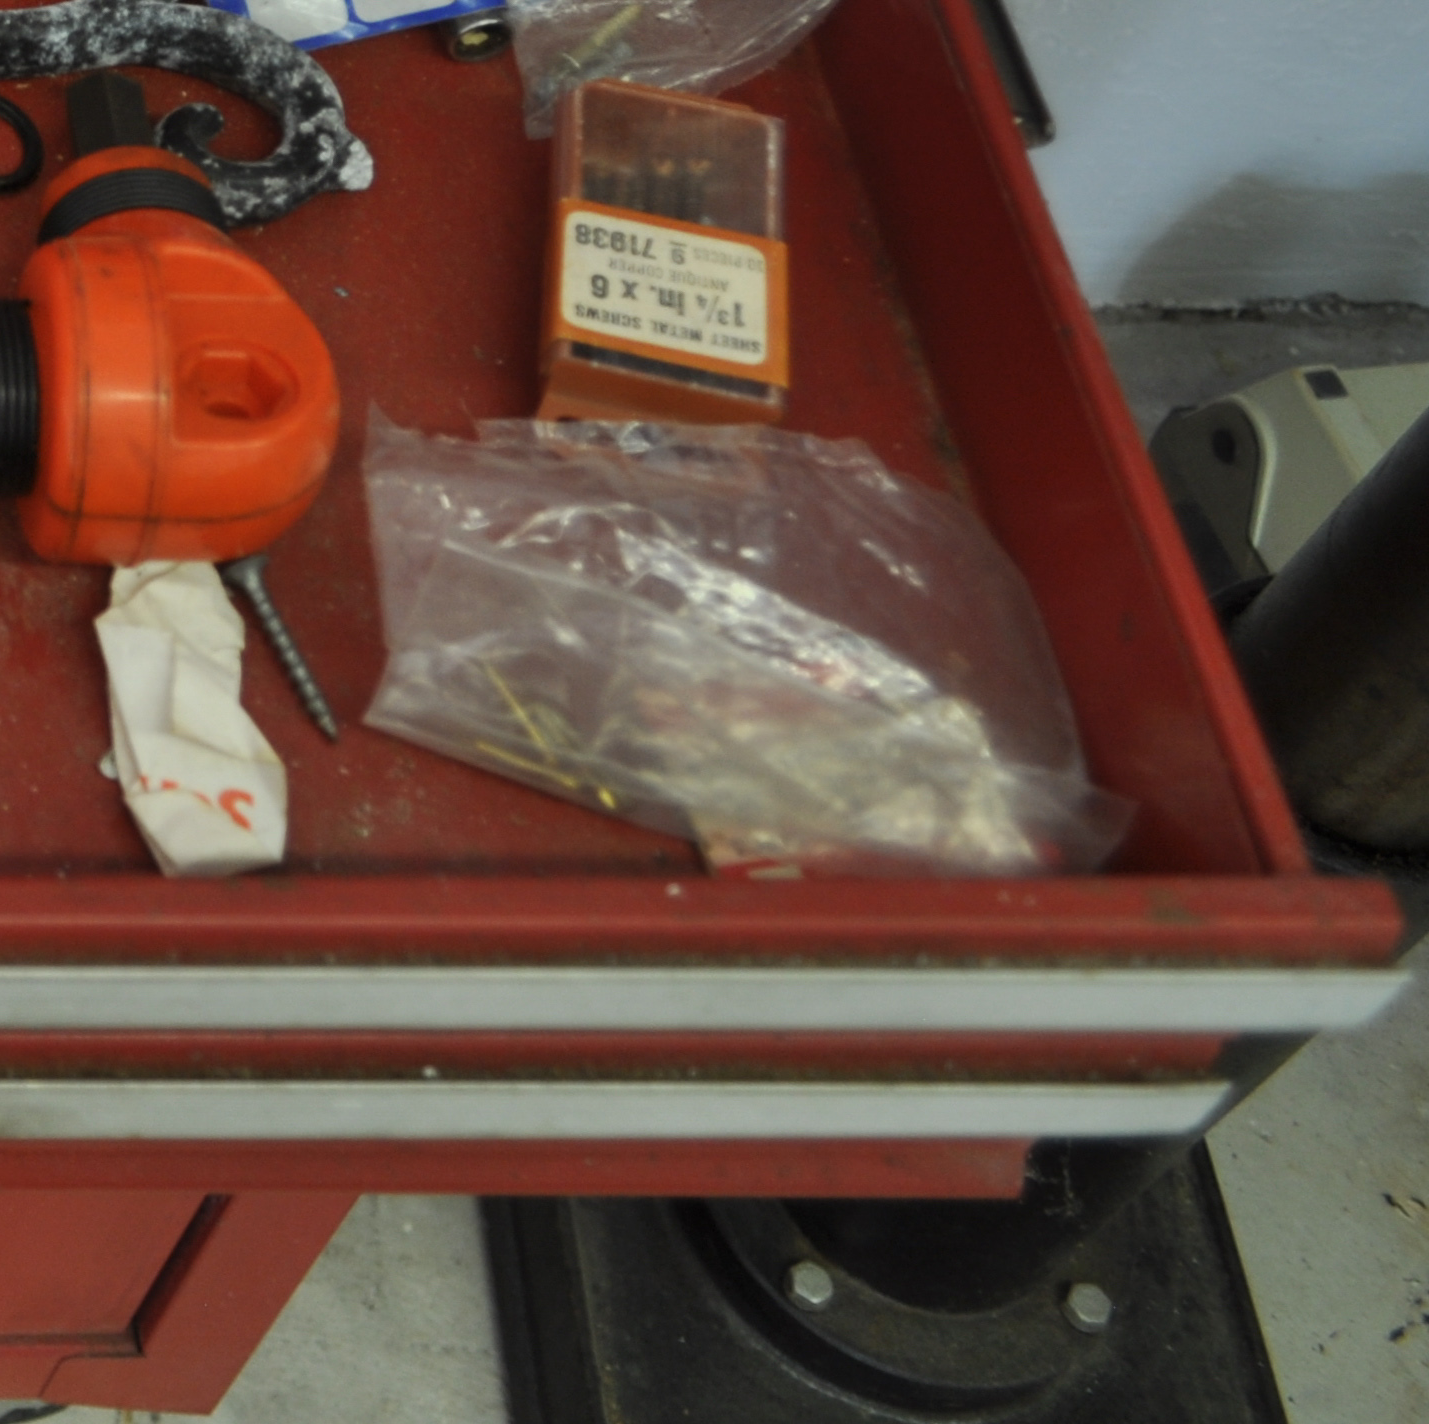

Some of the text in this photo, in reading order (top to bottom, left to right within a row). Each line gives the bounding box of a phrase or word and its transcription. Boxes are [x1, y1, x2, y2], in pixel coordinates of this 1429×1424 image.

[574, 223, 657, 261] 71938
[590, 274, 610, 300] 6
[608, 257, 730, 293] ANTIQUE COPPER
[574, 303, 762, 354] SHEET METAL SCREWS
